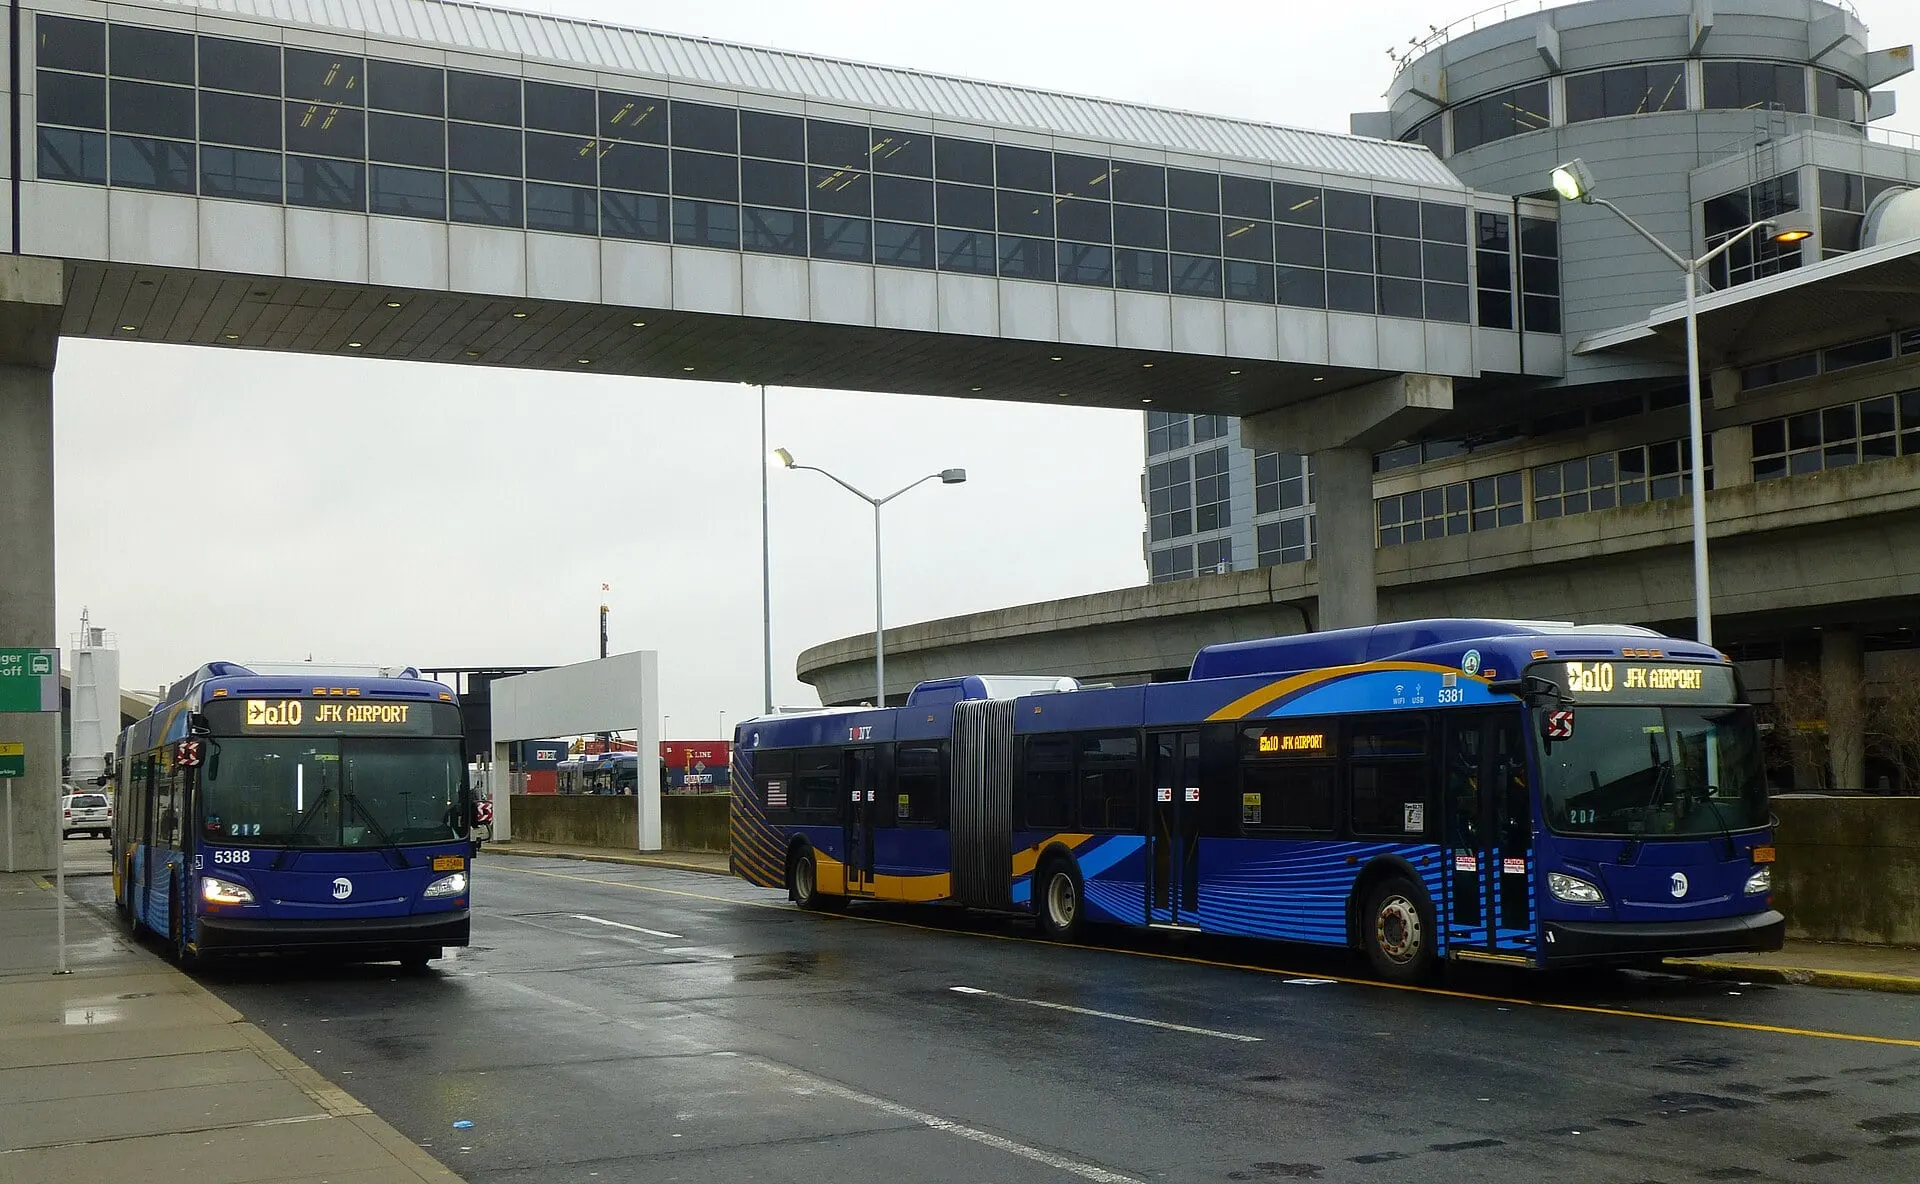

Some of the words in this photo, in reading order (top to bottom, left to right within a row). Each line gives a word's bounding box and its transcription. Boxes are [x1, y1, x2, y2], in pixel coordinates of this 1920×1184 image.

[1582, 662, 1614, 692] Q10
[1623, 668, 1646, 688] JFK
[1649, 668, 1702, 689] AIRPORT
[1393, 697, 1405, 705] WIFI
[1412, 696, 1424, 704] USB
[1438, 688, 1463, 703] 5381
[265, 700, 302, 725] Q10
[315, 704, 342, 722] JFK
[346, 705, 409, 723] AIRPORT
[849, 727, 854, 741] I
[859, 726, 872, 740] NY
[1281, 736, 1294, 750] JFK
[1294, 734, 1323, 750] AIRPORT
[231, 823, 260, 836] 212
[214, 850, 250, 863] 5388
[333, 882, 349, 895] MTA
